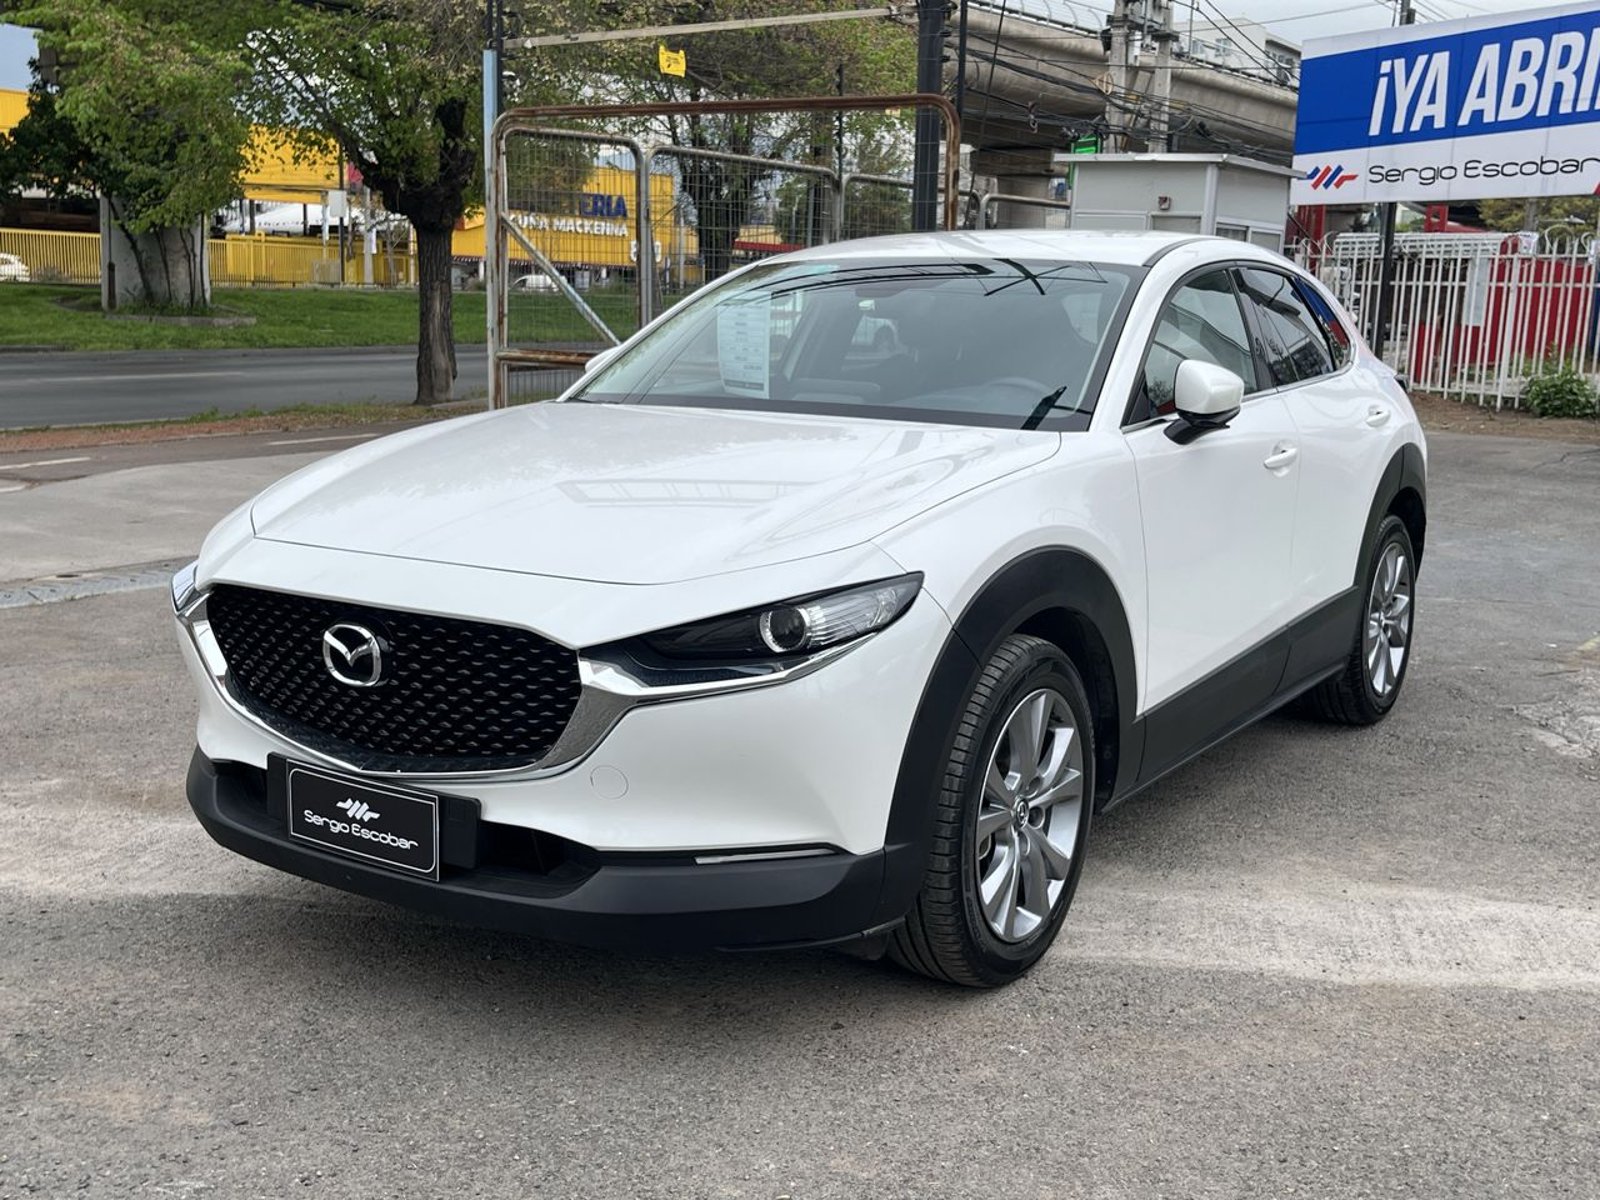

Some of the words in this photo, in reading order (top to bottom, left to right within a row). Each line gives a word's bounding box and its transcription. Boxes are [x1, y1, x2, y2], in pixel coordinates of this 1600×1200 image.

[1368, 165, 1457, 186] Sergio
[1464, 156, 1600, 178] Escobar
[580, 193, 628, 219] ERIA
[509, 212, 549, 231] CUÑA
[552, 217, 629, 237] MACKENNA
[350, 822, 419, 850] Escobar
